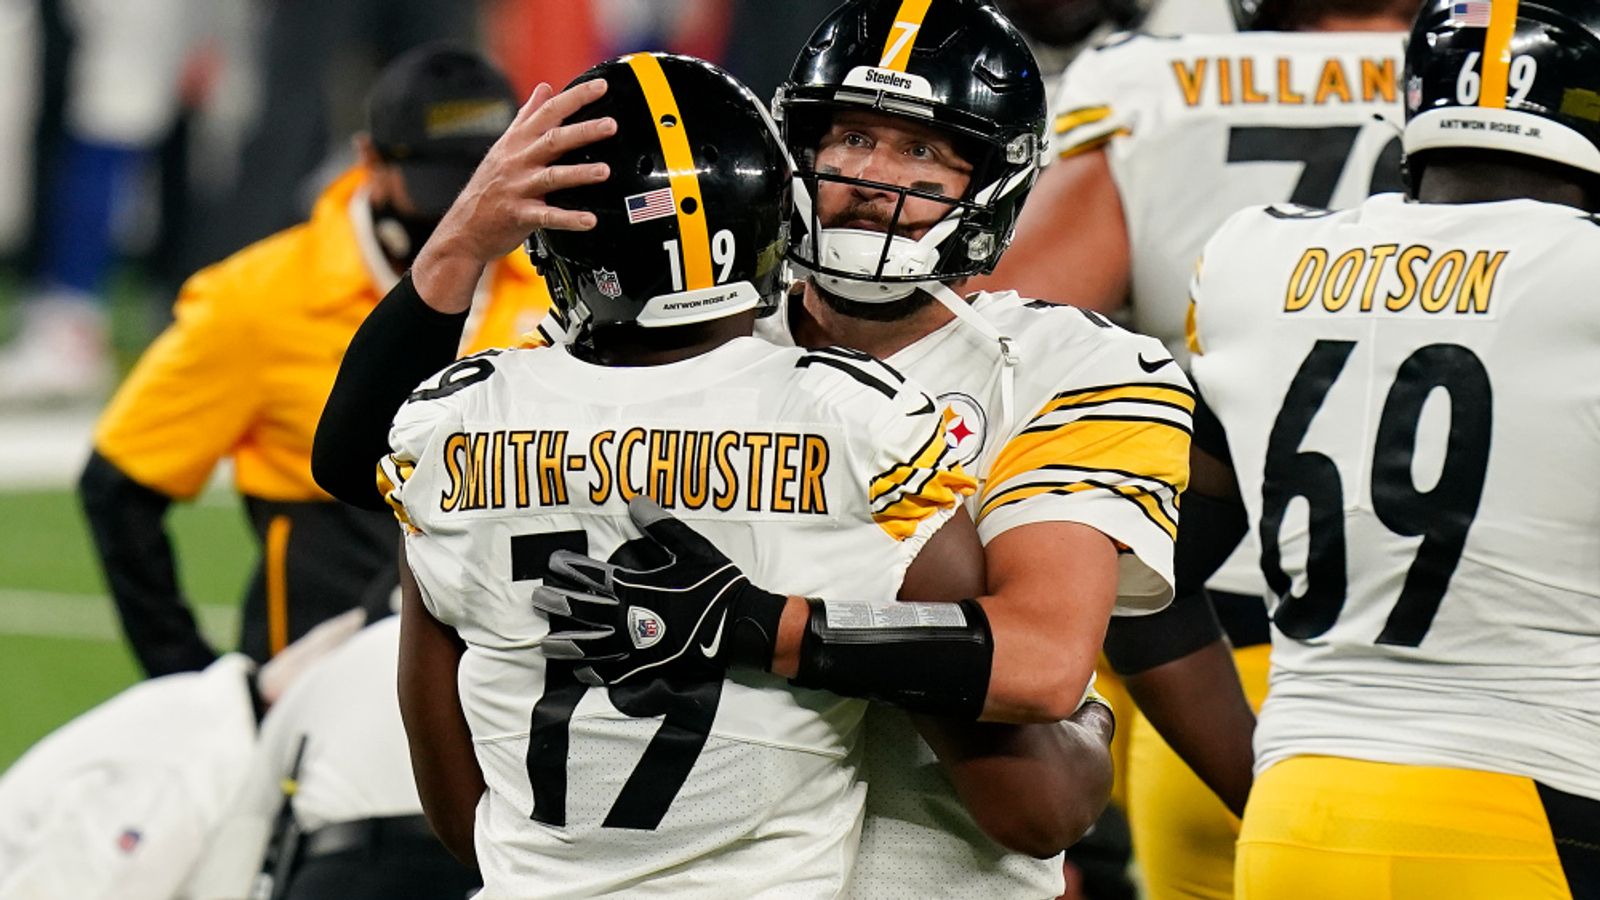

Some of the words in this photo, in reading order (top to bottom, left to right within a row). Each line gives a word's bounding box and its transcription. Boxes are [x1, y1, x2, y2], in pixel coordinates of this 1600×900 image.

[879, 21, 921, 67] 7
[865, 69, 912, 89] Steelers
[1171, 57, 1398, 107] VILLAN
[1440, 119, 1486, 131] ANTWON
[1489, 121, 1521, 135] ROSE
[1283, 243, 1509, 314] DOTSON
[662, 299, 702, 311] ANTWON
[702, 295, 725, 307] ROSE
[440, 426, 831, 515] SMITH-SCHUSTER
[1259, 339, 1494, 648] 69
